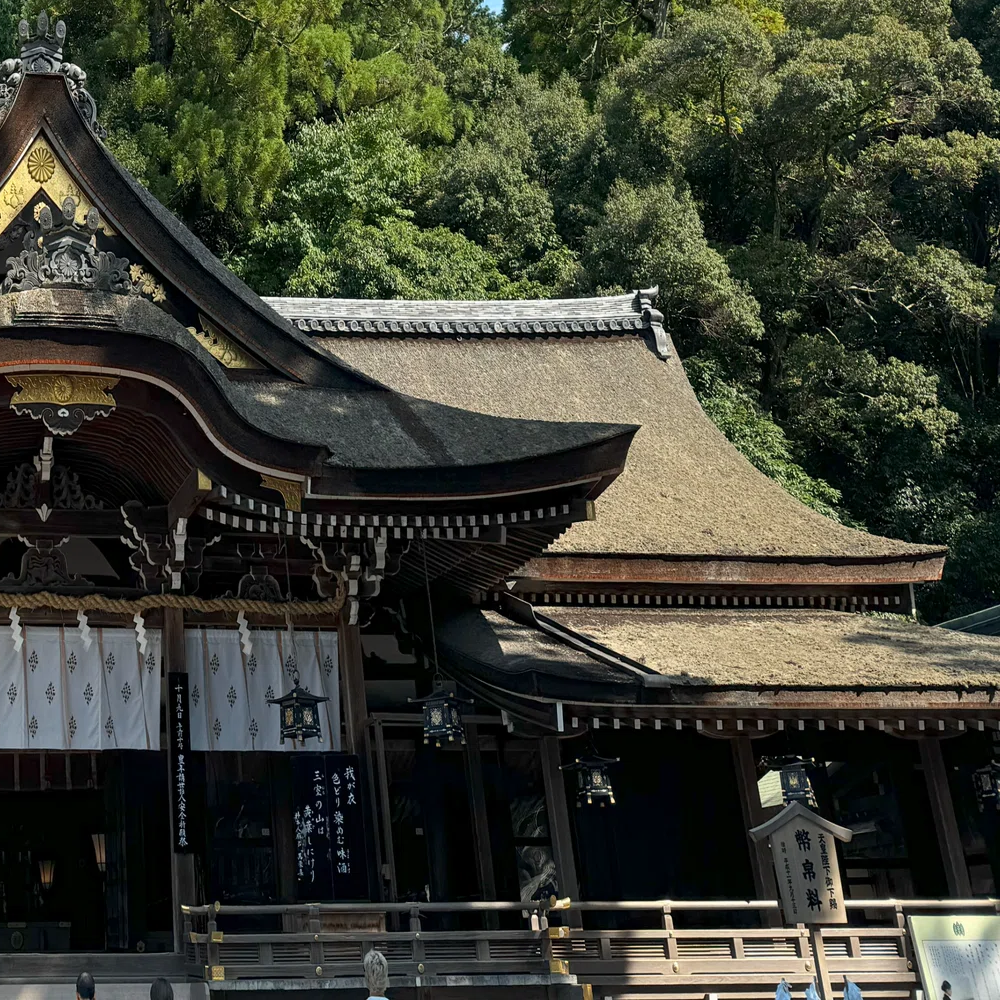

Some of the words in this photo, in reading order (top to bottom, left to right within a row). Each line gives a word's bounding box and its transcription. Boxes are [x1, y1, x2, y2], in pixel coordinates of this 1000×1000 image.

[174, 684, 184, 719] 十月九日
[344, 765, 357, 806] 我が衣
[794, 829, 823, 912] 幣帛料
